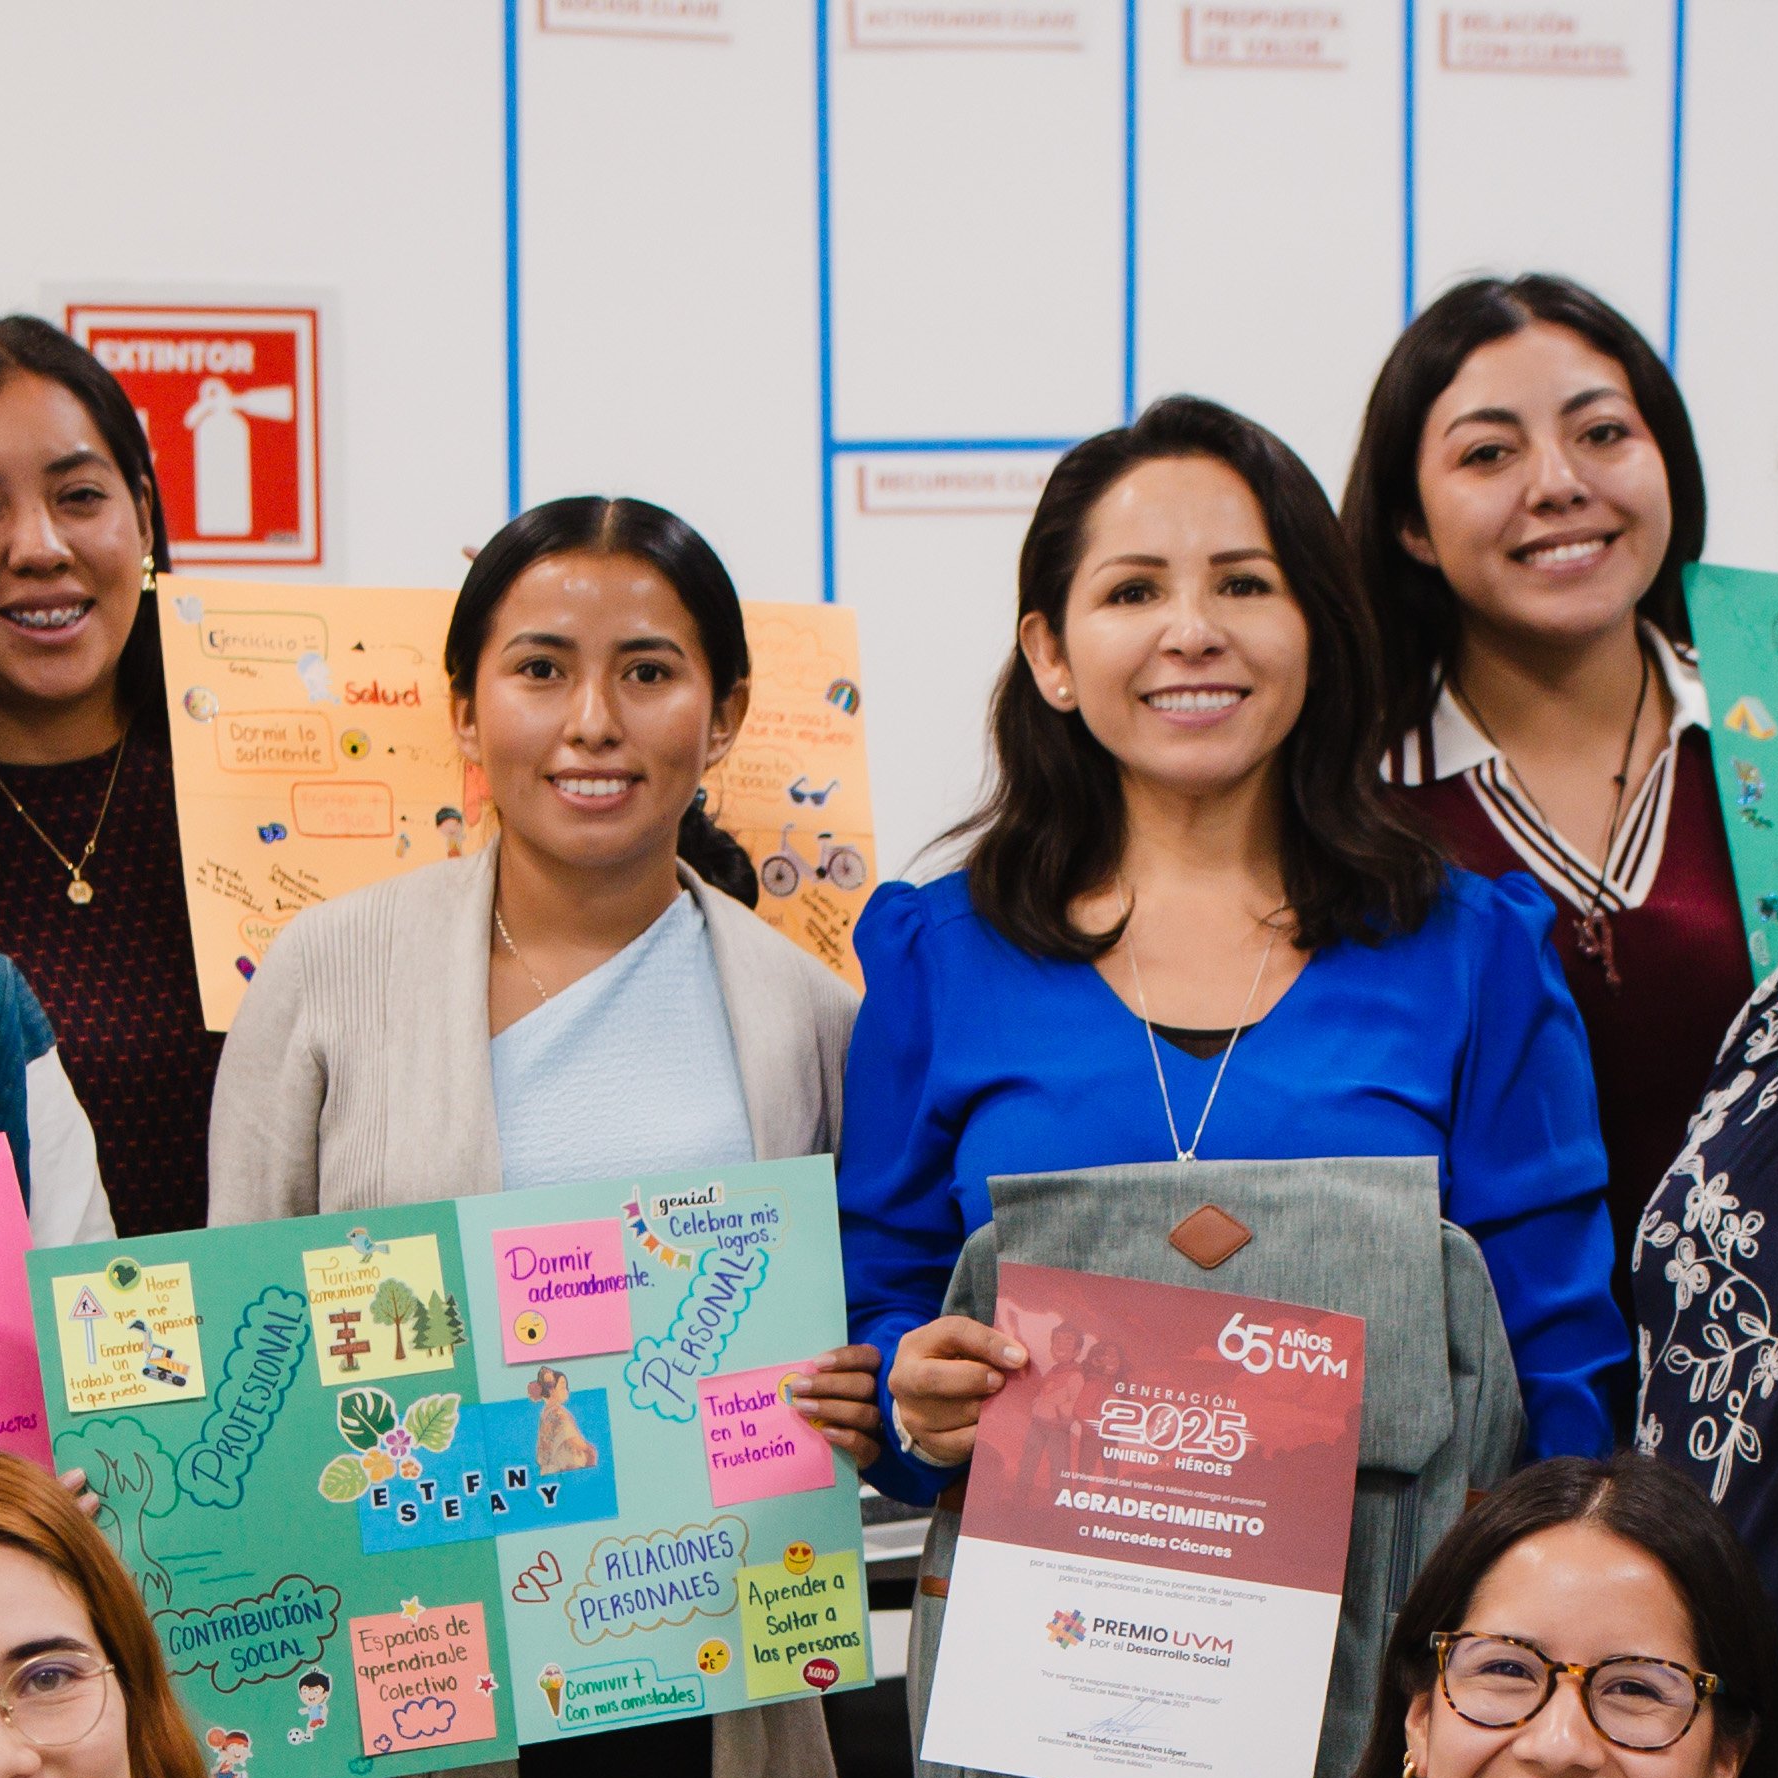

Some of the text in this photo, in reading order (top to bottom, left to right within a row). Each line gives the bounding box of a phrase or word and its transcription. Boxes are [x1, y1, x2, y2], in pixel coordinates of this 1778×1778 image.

[95, 339, 256, 375] EXTINTOR
[343, 681, 423, 709] Salud
[229, 722, 288, 745] Dormir
[234, 745, 323, 767] suficiente
[669, 1203, 780, 1238] Celebrar mis
[717, 1228, 777, 1257] logros.
[310, 1256, 381, 1284] Turismo
[504, 1245, 594, 1282] Dormir
[145, 1276, 181, 1292] Hacer
[155, 1292, 170, 1304] lo
[308, 1283, 378, 1305] Comunitario
[114, 1304, 168, 1324] que me
[152, 1313, 205, 1334] apasiona
[642, 1254, 756, 1406] PERSONAL
[1217, 1312, 1275, 1376] 65
[1278, 1328, 1334, 1353] AÑOS
[112, 1359, 130, 1371] un
[118, 1371, 138, 1384] en
[1276, 1346, 1349, 1379] UVM
[85, 1383, 148, 1407] que puedo
[191, 1309, 304, 1490] PROFESIONAL
[704, 1388, 777, 1418] Trabajar
[1114, 1381, 1239, 1410] GENERACIÓN
[710, 1421, 758, 1441] en la
[1099, 1398, 1248, 1463] 2025
[711, 1435, 797, 1470] Frustación
[1174, 1454, 1233, 1477] HÉROES
[1054, 1487, 1265, 1537] AGRADECIMIENTO
[604, 1530, 735, 1583] RELACIONES
[1078, 1524, 1233, 1559] a Mercedes Cáceres
[579, 1570, 721, 1630] PERSONALES
[747, 1574, 846, 1607] Aprender a
[766, 1607, 837, 1636] Soltar a
[1091, 1616, 1234, 1654] PREMIO UVM
[357, 1615, 471, 1659] Espacios de
[753, 1631, 862, 1664] las personas
[230, 1637, 307, 1675] SOCIAL
[1088, 1637, 1231, 1668] por el Desarrollo Social
[378, 1674, 459, 1702] Colectivo
[565, 1672, 631, 1702] Convivir
[805, 1665, 836, 1683] XOXO
[565, 1685, 697, 1723] Con mis amistades
